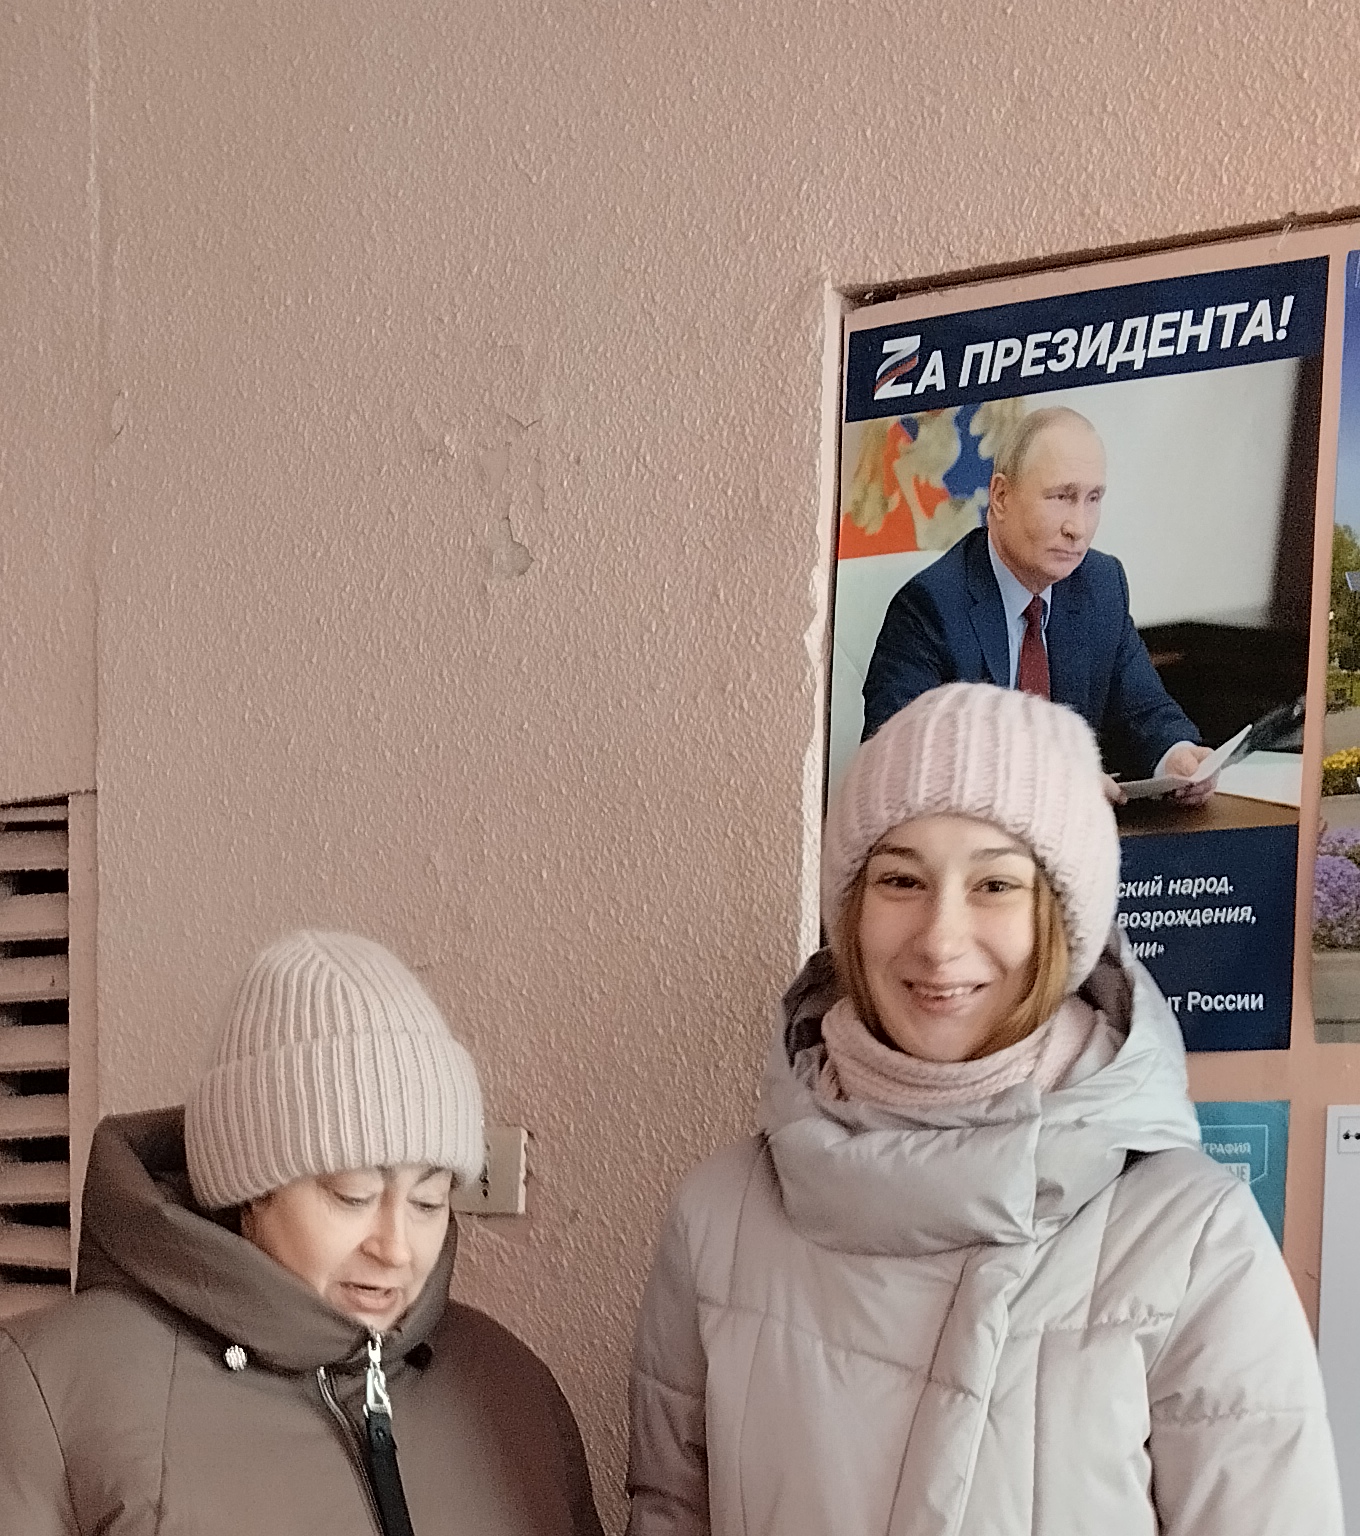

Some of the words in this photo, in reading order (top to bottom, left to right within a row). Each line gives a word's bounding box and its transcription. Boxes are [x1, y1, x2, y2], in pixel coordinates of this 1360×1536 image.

[958, 294, 1296, 389] ПРЕЗИДЕНТА!
[1168, 876, 1234, 900] народ.
[1117, 906, 1257, 932] возрождения,
[1130, 942, 1165, 959] ии»
[1187, 991, 1265, 1013] России
